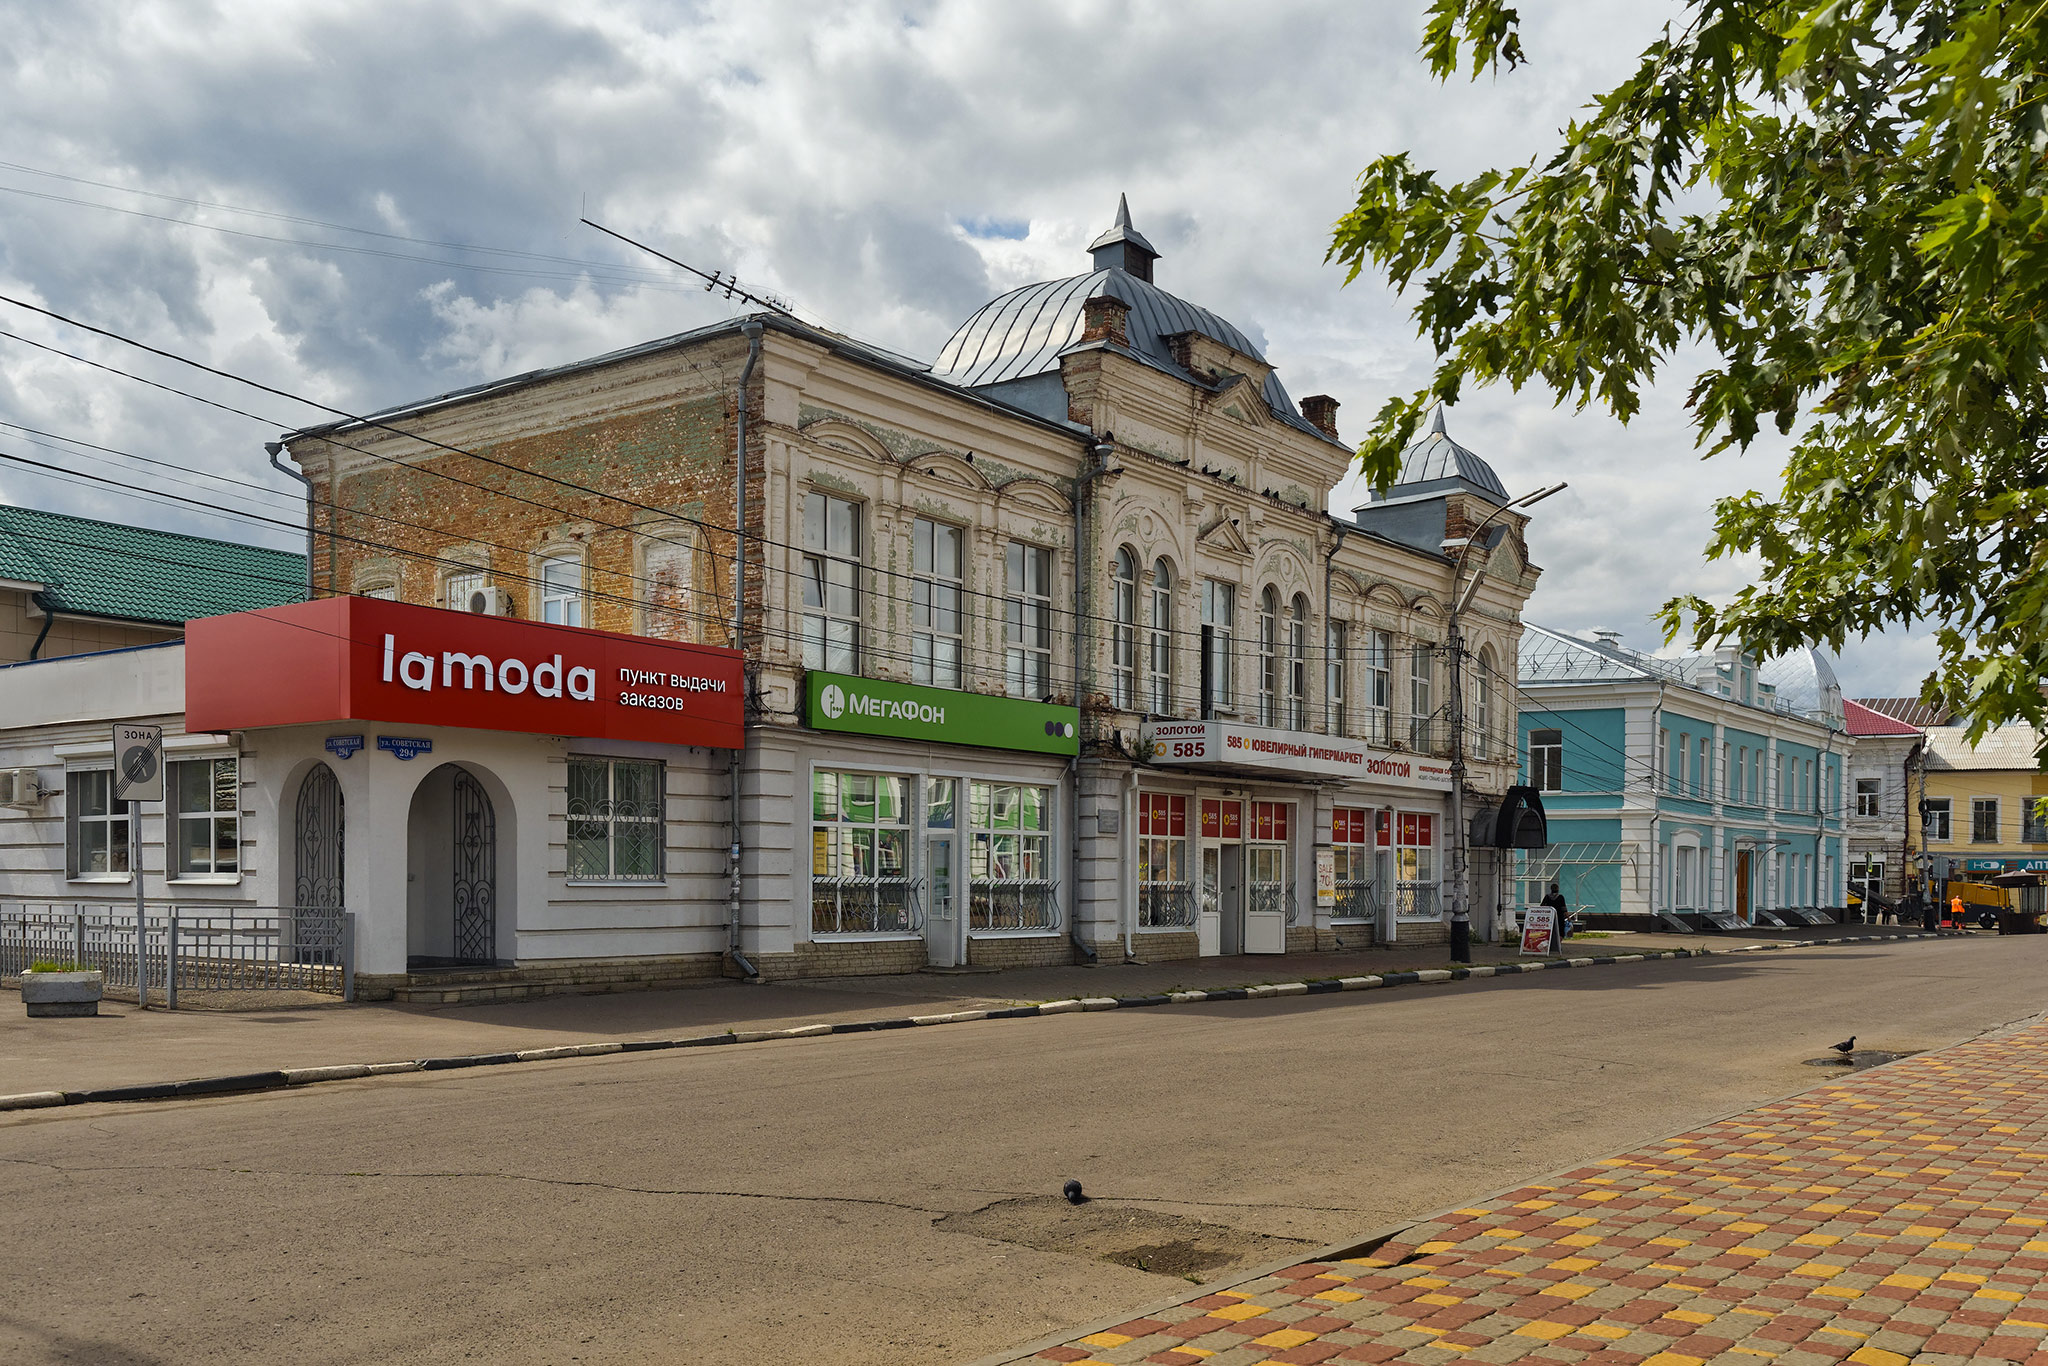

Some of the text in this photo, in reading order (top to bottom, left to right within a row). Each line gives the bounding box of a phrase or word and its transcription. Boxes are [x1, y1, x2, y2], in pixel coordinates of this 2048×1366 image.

[383, 633, 596, 701] lamoda
[620, 668, 726, 693] пункт выдачи
[620, 692, 684, 711] заказов
[124, 730, 153, 740] ЗОНА
[1156, 724, 1205, 735] ЗОЛОТОЙ
[333, 738, 360, 746] СОВЕТСКАЯ
[392, 739, 431, 748] СОВЕТСКАЯ
[1173, 742, 1205, 757] 585
[1227, 735, 1364, 764] 585 ЮВЕЛИРНЫЙ ГИПЕРМАРКЕТ
[400, 749, 414, 757] 294
[1367, 759, 1411, 777] ЗОЛОТОЙ
